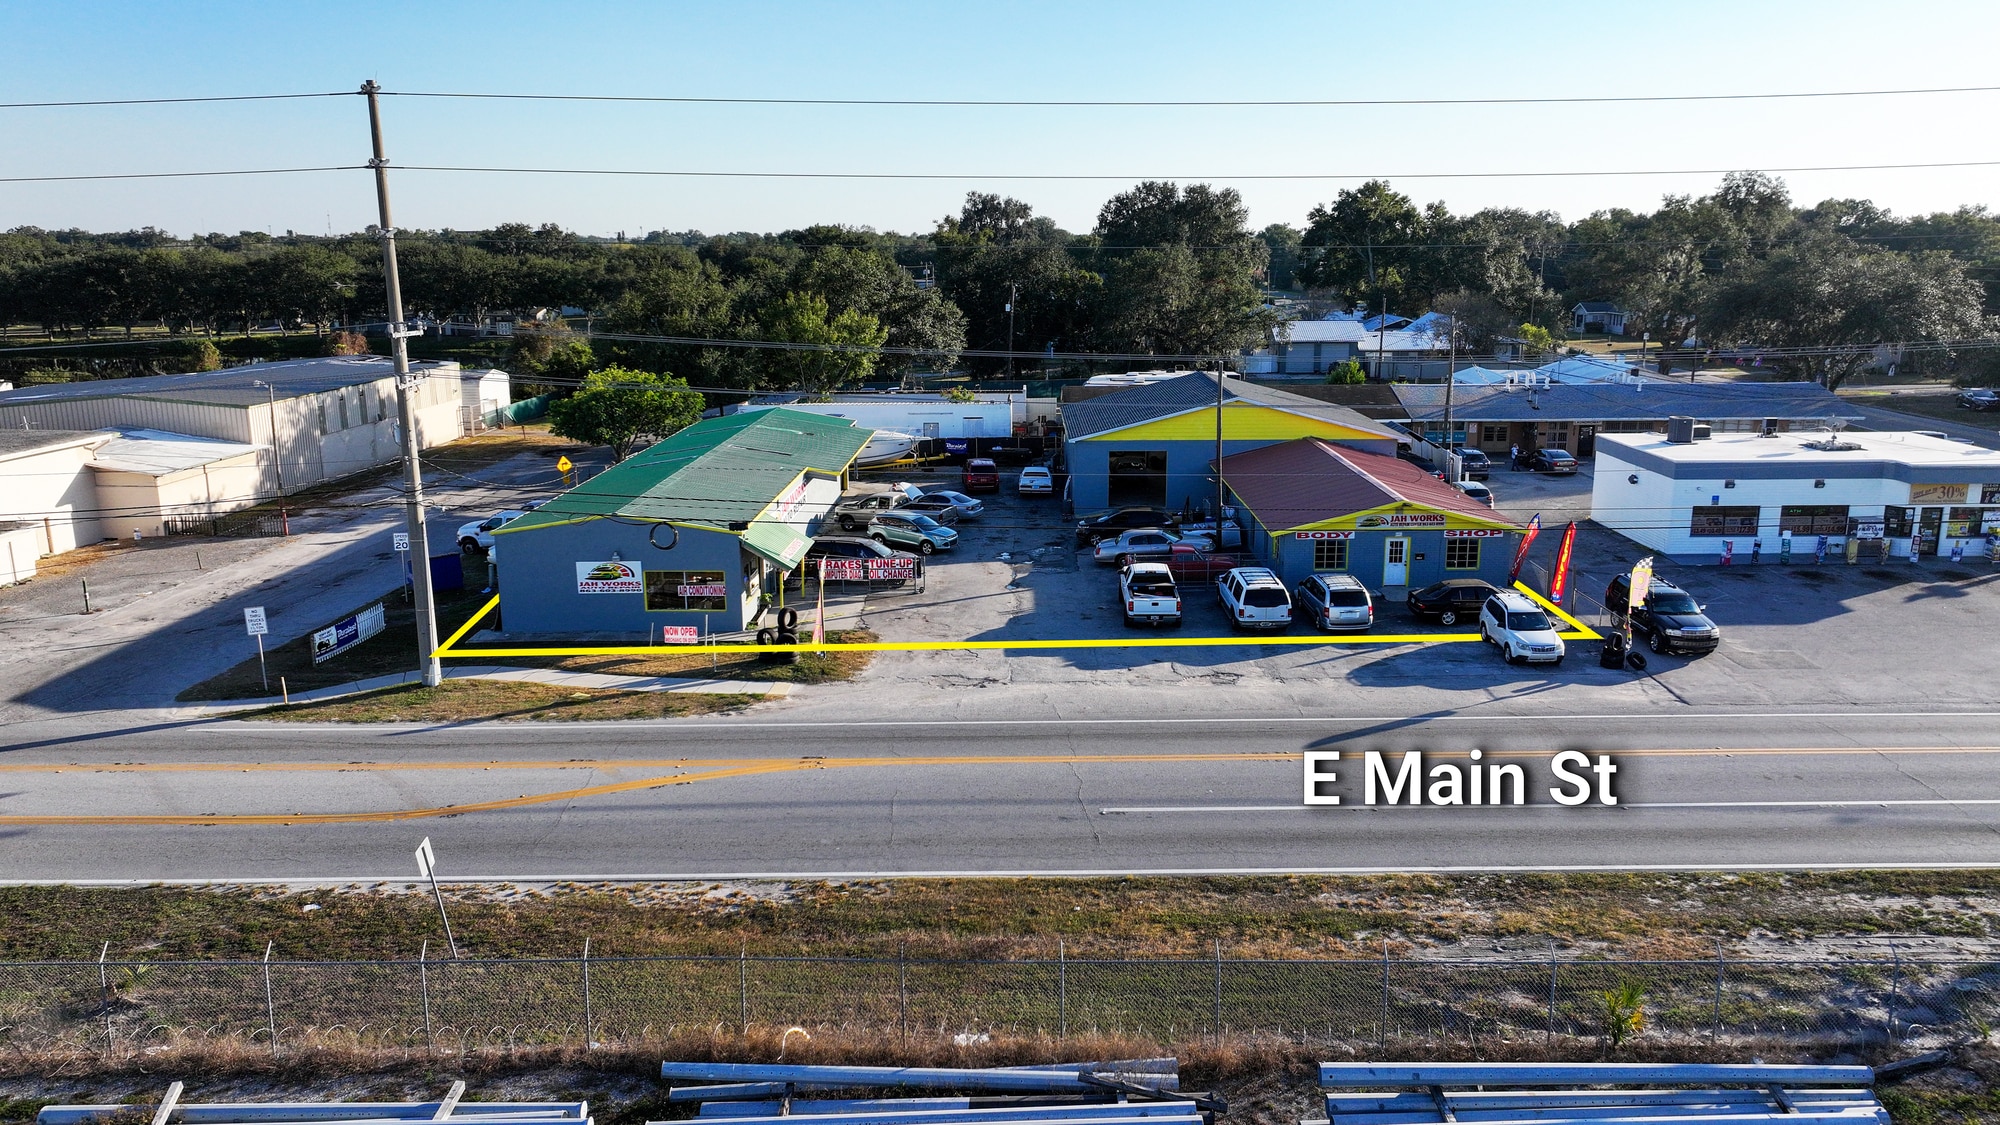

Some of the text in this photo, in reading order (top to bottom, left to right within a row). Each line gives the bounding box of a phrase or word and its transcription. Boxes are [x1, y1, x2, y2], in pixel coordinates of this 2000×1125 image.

[1938, 485, 1965, 499] 30%
[1409, 514, 1445, 522] WORKS
[395, 541, 408, 549] 20
[869, 559, 912, 568] TUNE-UP
[869, 570, 912, 578] OIL CHANGE
[678, 585, 726, 595] AIR CONDITIONING
[664, 626, 697, 636] NOW OPEN
